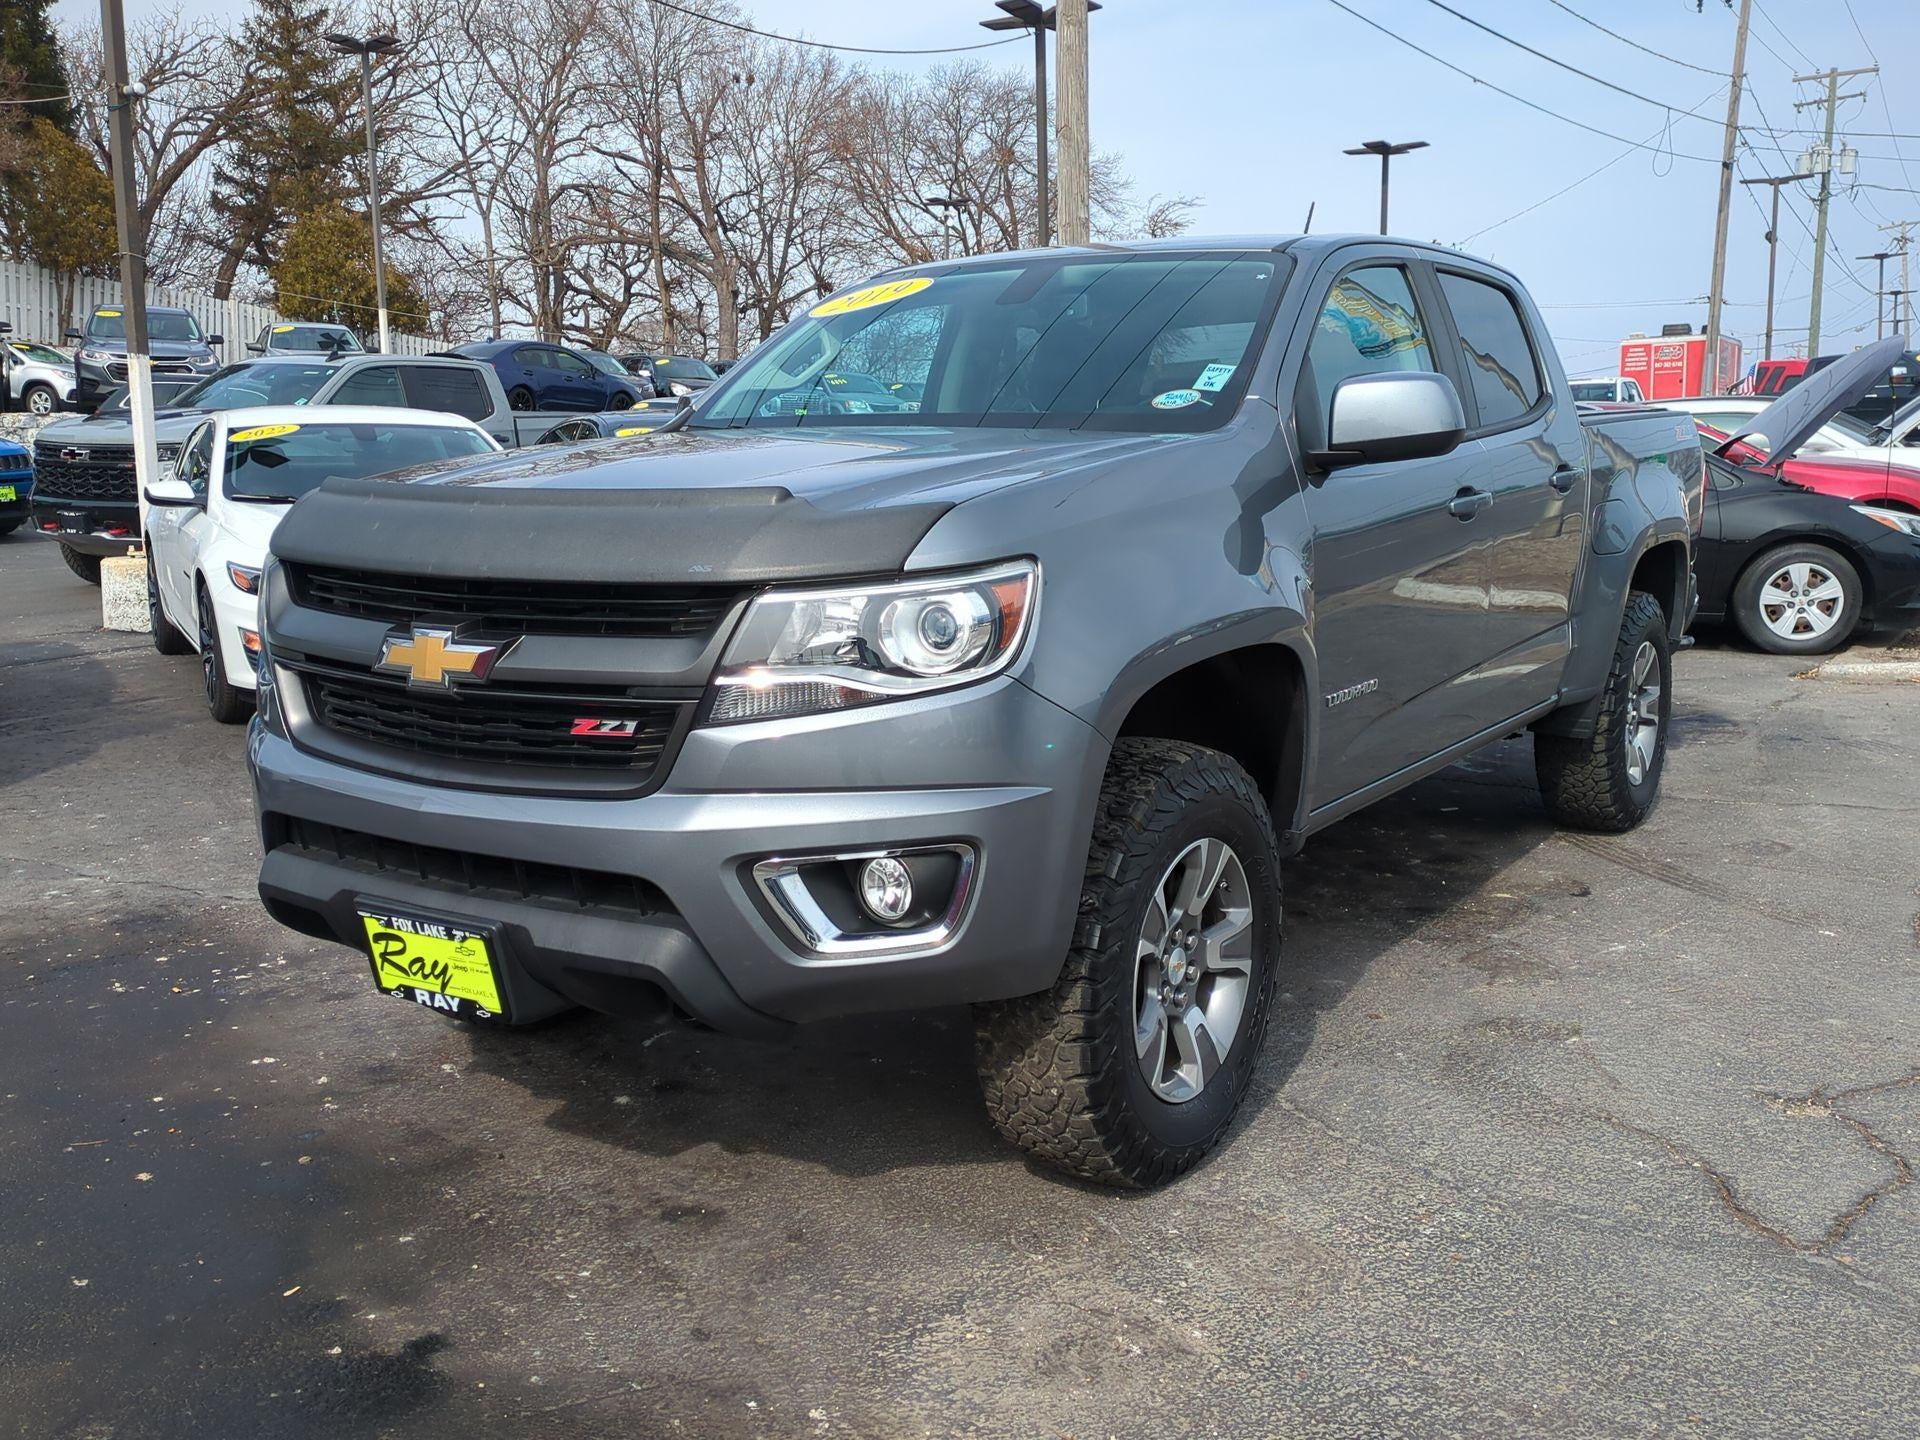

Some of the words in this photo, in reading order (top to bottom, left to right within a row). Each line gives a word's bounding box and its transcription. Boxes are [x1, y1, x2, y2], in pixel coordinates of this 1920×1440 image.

[244, 426, 286, 440] 2022
[1325, 679, 1379, 708] COLORADO
[570, 718, 639, 737] Z71
[391, 916, 415, 933] FOX
[417, 922, 448, 939] LAKE
[372, 932, 453, 993] Ray
[414, 988, 461, 1012] RAY
